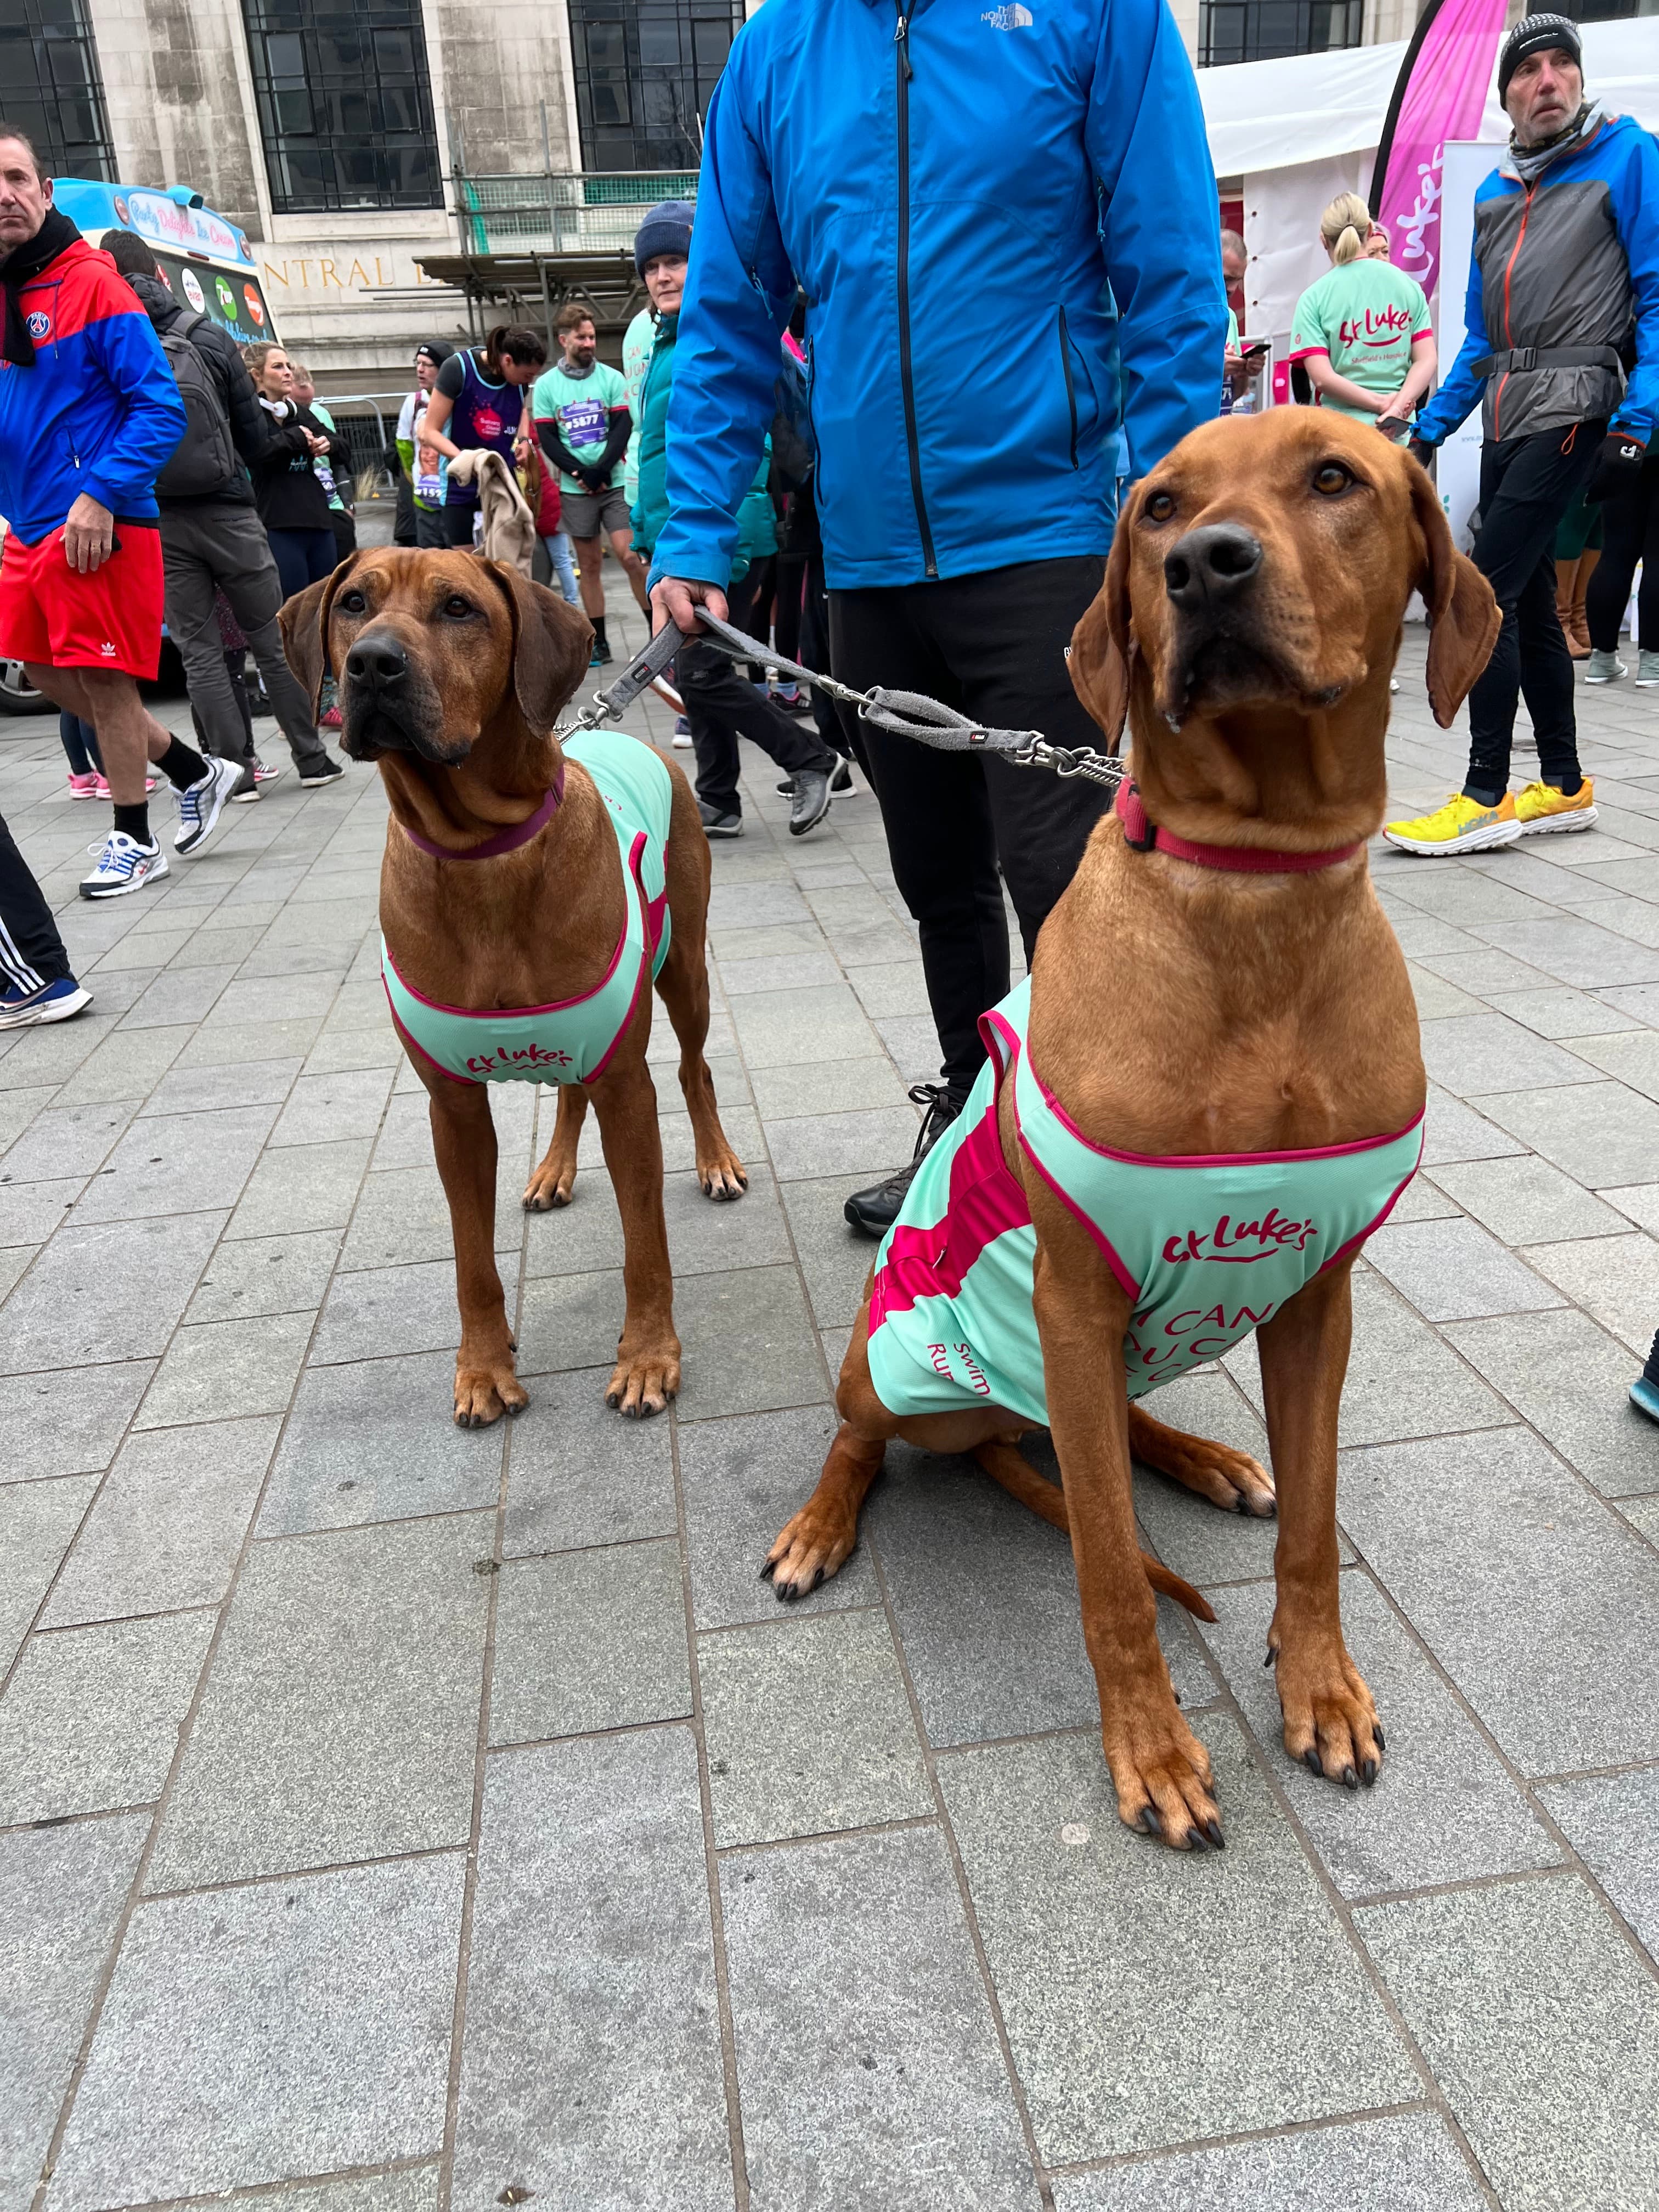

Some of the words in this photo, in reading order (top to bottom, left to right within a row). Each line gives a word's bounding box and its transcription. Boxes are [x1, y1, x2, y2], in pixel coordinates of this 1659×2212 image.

[497, 1043, 573, 1066] Luke's
[1213, 1207, 1318, 1251] Luke's
[1164, 1302, 1274, 1336] CAN
[953, 1342, 991, 1396] Swim
